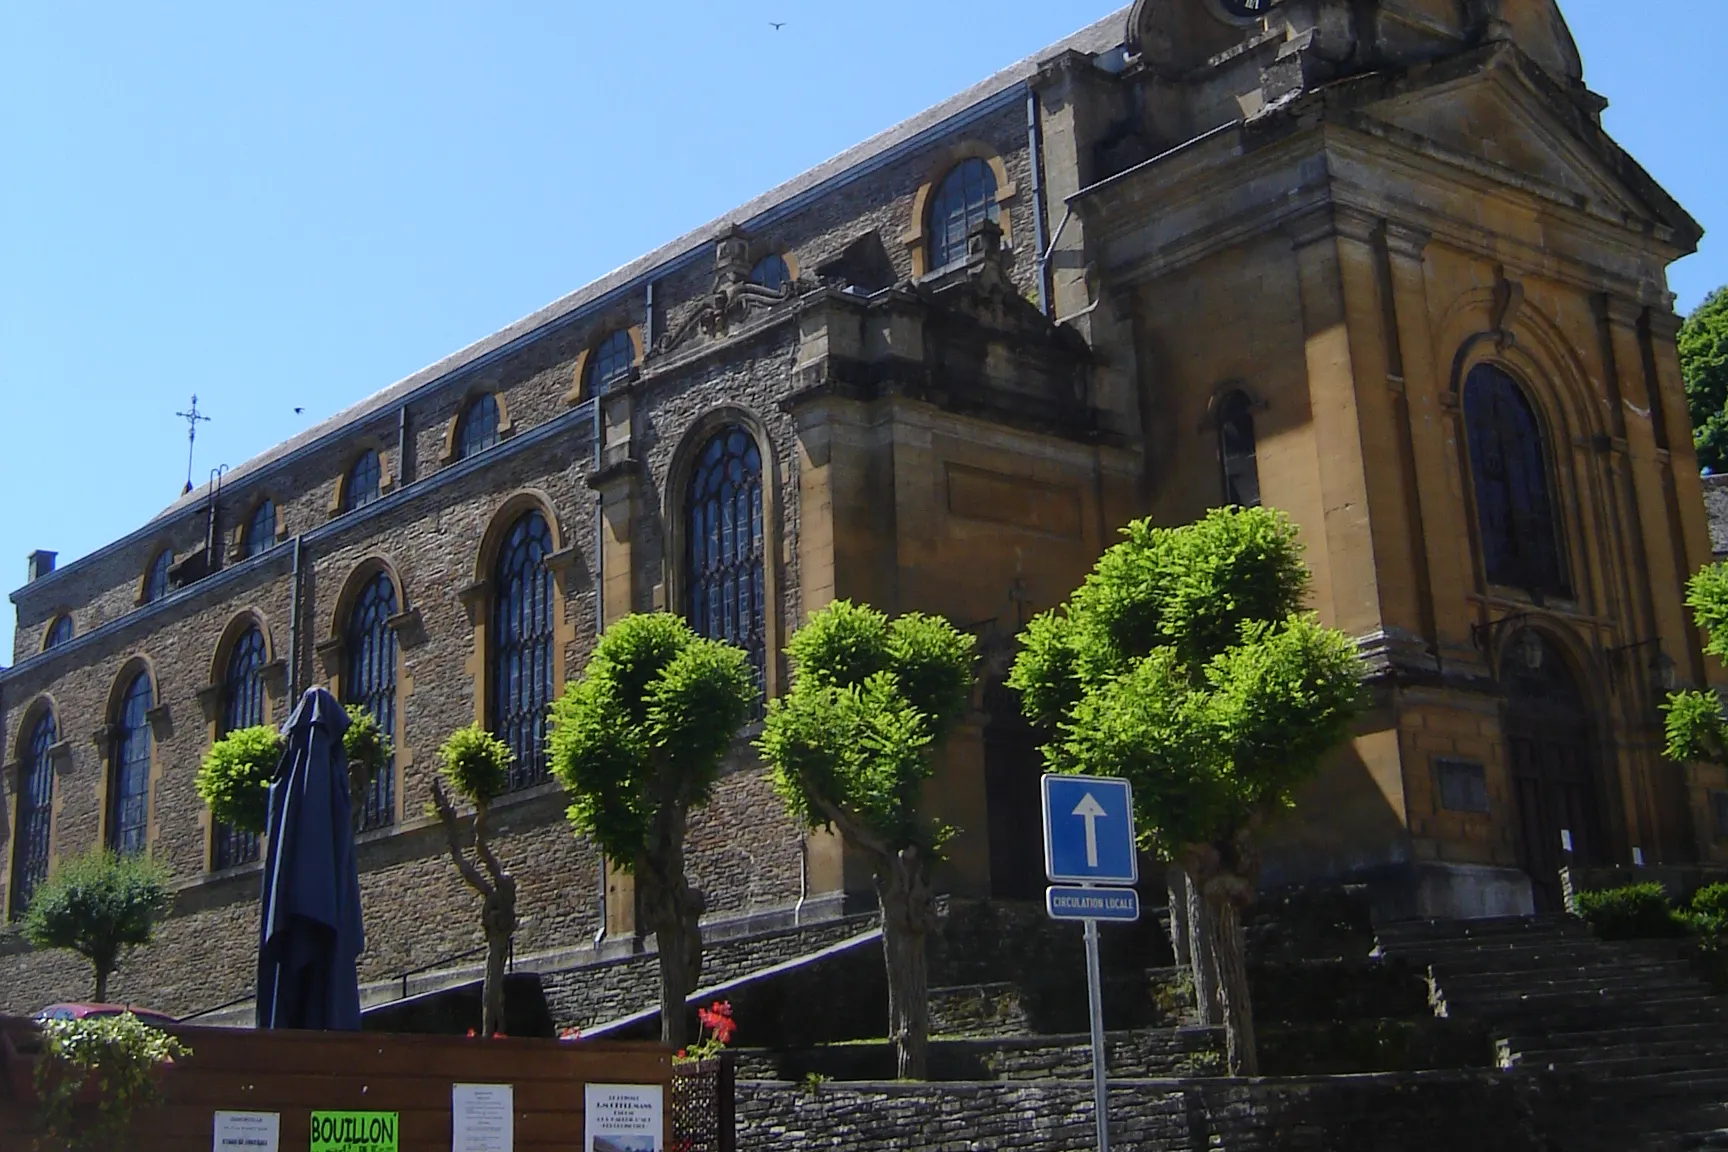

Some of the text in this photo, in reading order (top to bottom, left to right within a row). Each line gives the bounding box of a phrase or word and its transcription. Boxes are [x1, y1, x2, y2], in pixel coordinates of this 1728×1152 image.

[1053, 896, 1134, 909] CIRCULATION LOCALE
[311, 1115, 394, 1144] BOUILLON
